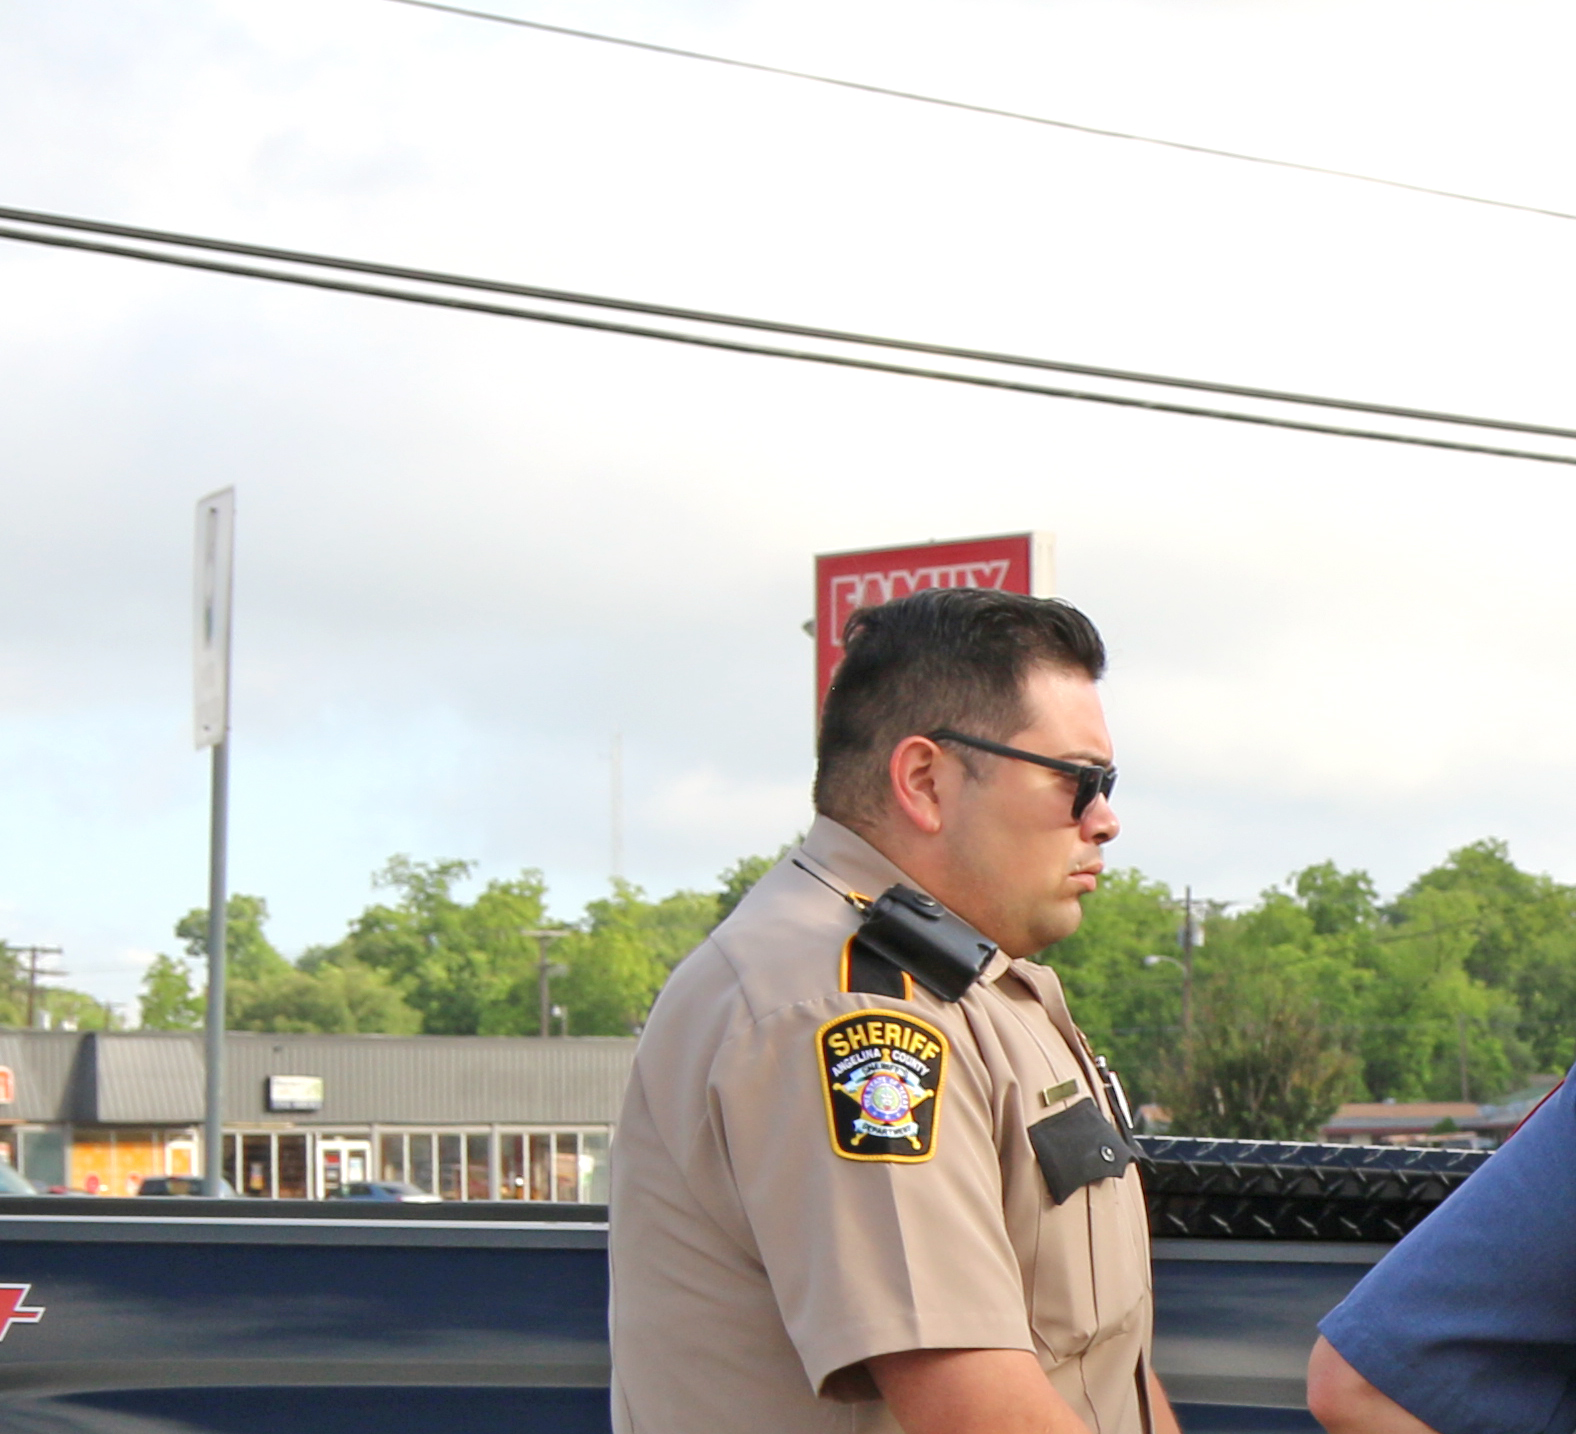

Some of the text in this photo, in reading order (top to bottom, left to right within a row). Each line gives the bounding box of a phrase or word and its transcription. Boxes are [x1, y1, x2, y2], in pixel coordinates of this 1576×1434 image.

[828, 1021, 940, 1060] SHERIFF
[831, 1048, 930, 1078] ANGELINA COUNTY
